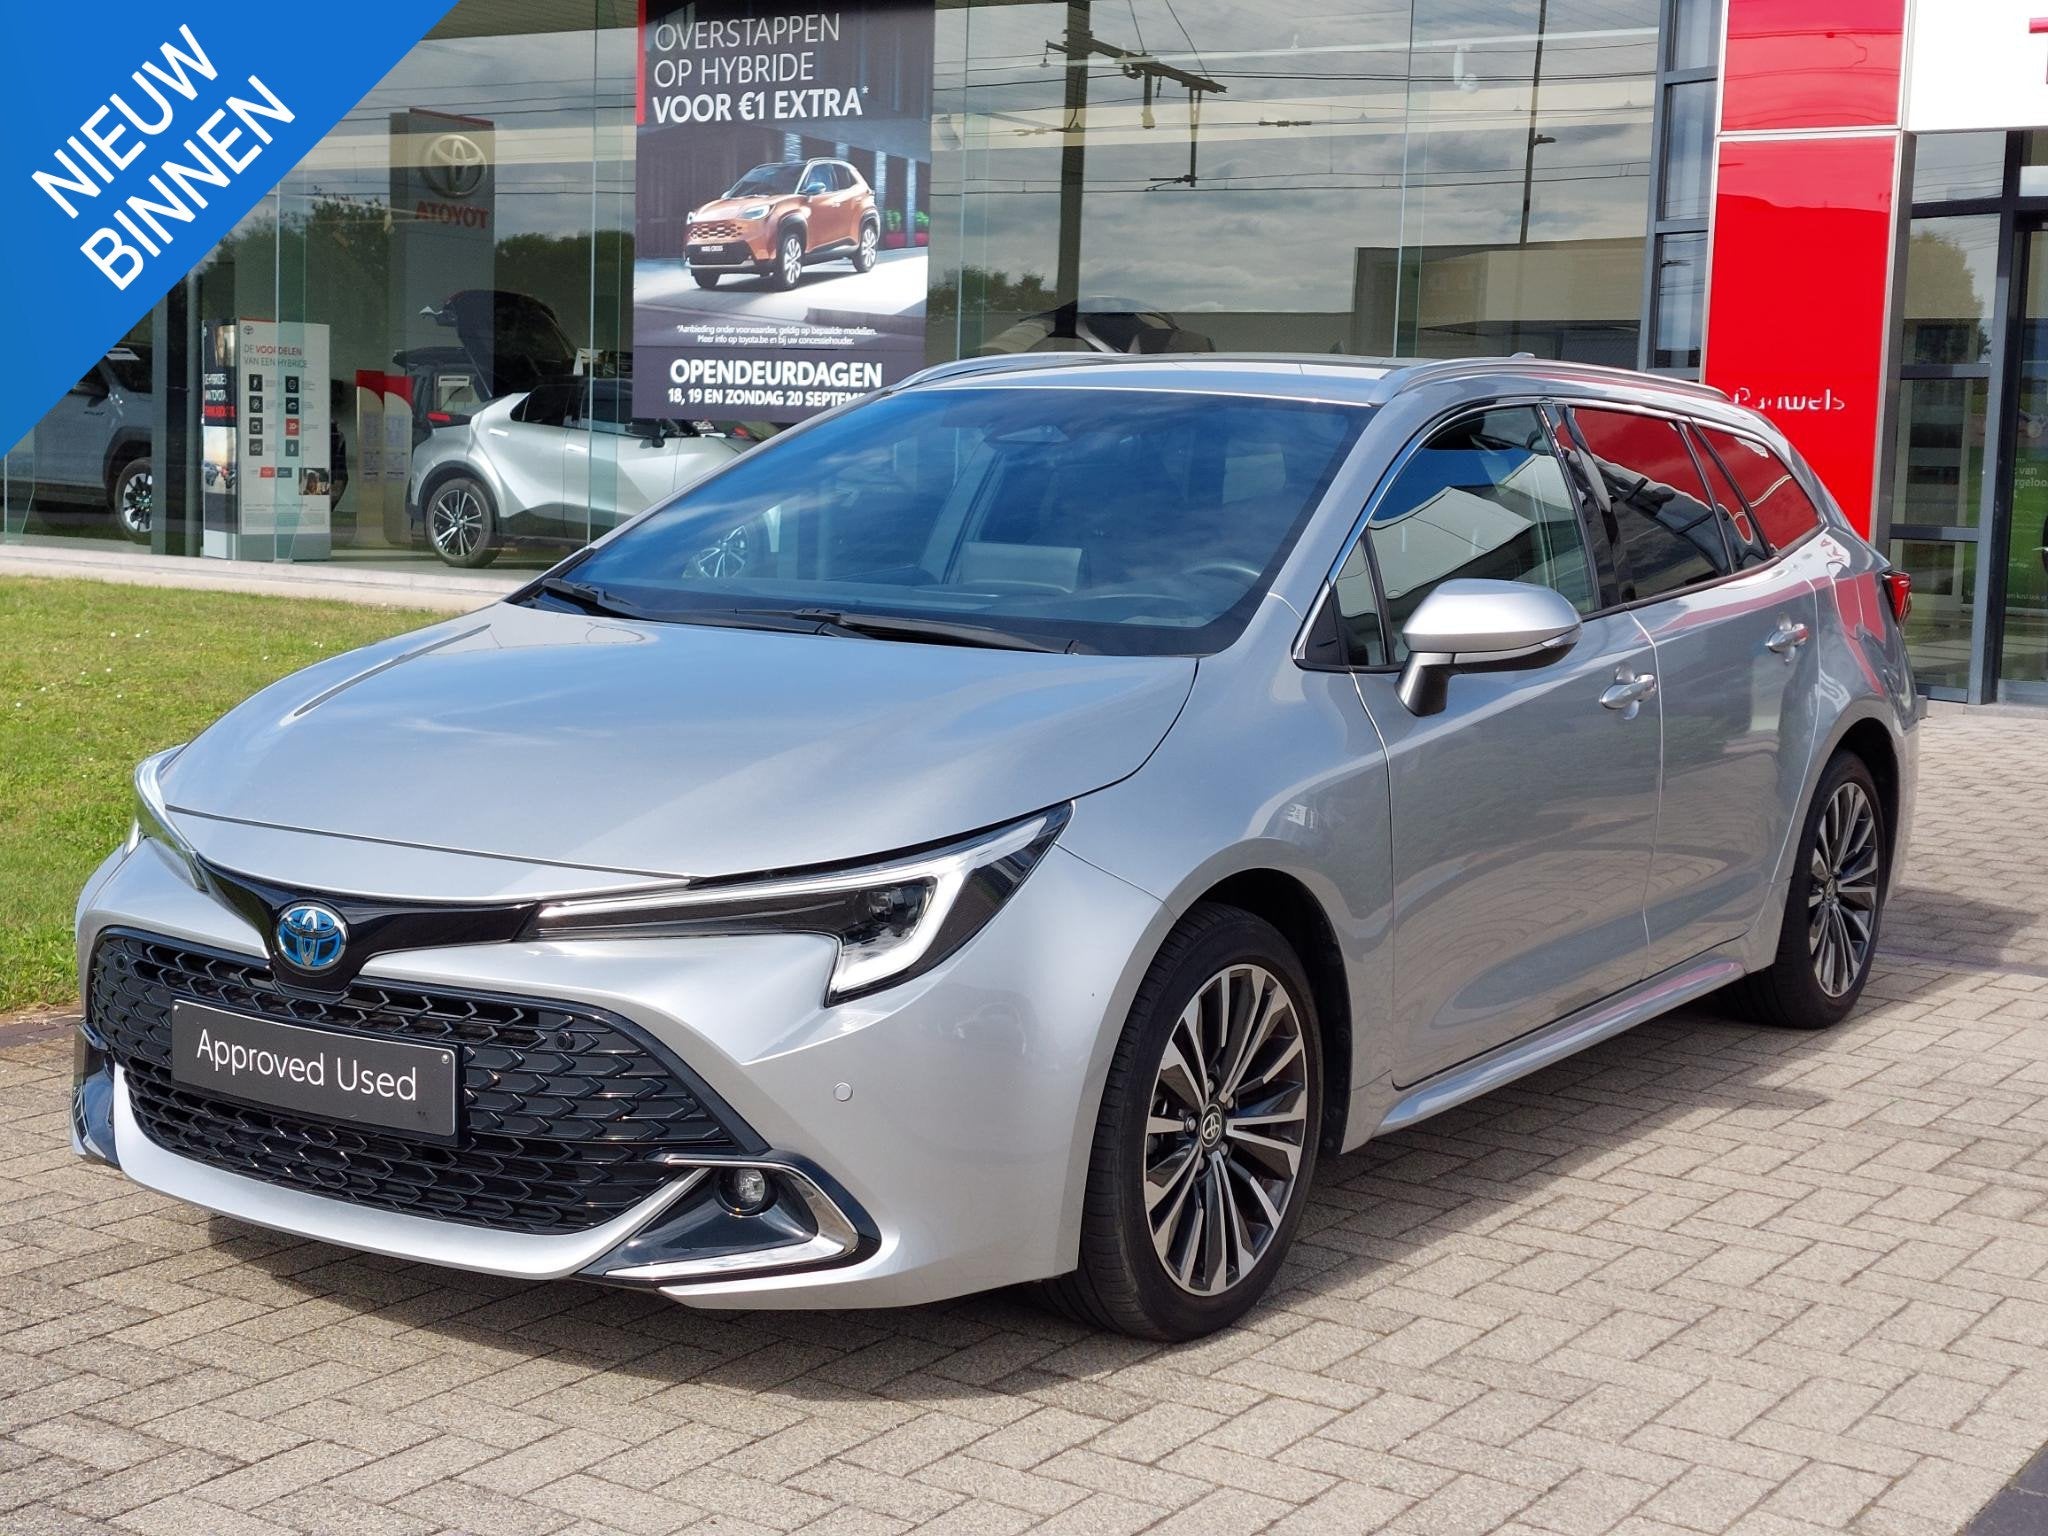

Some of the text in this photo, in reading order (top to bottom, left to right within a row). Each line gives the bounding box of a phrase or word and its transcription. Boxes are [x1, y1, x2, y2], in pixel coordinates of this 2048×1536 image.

[654, 13, 841, 52] OVERSTAPPEN
[653, 52, 815, 88] OP HYBRIDE
[652, 93, 732, 124] VOOR
[738, 91, 765, 121] €1
[669, 358, 883, 388] OPENDEURDAGEN
[667, 387, 867, 407] 18, 19 EN ZONDAG 20 SEPTEM
[196, 1028, 417, 1102] Approved Used
